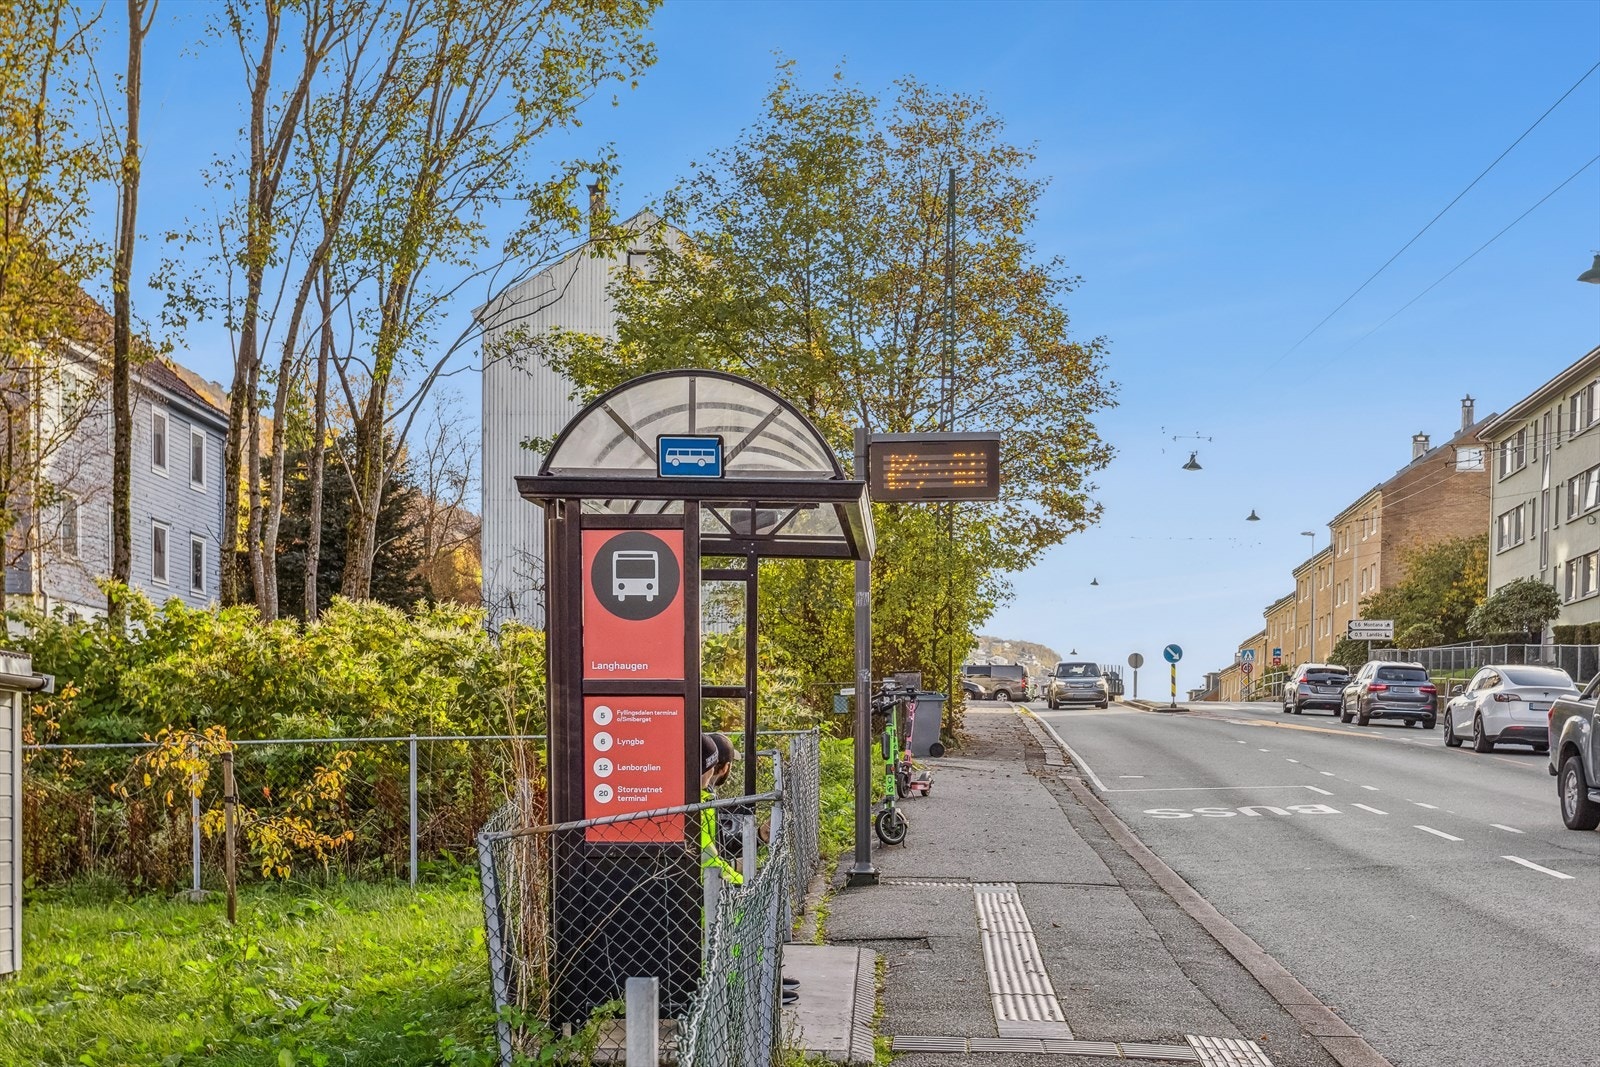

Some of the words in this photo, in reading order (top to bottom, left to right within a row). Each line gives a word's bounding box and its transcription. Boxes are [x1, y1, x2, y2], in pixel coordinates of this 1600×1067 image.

[591, 661, 649, 671] Langhaugen
[616, 709, 654, 717] Fyllingsdalen
[616, 738, 645, 746] Lyngbø
[617, 764, 661, 772] Lønborglien
[617, 785, 663, 793] Storavatnet
[617, 794, 648, 802] terminal
[1142, 803, 1343, 819] BUSS
